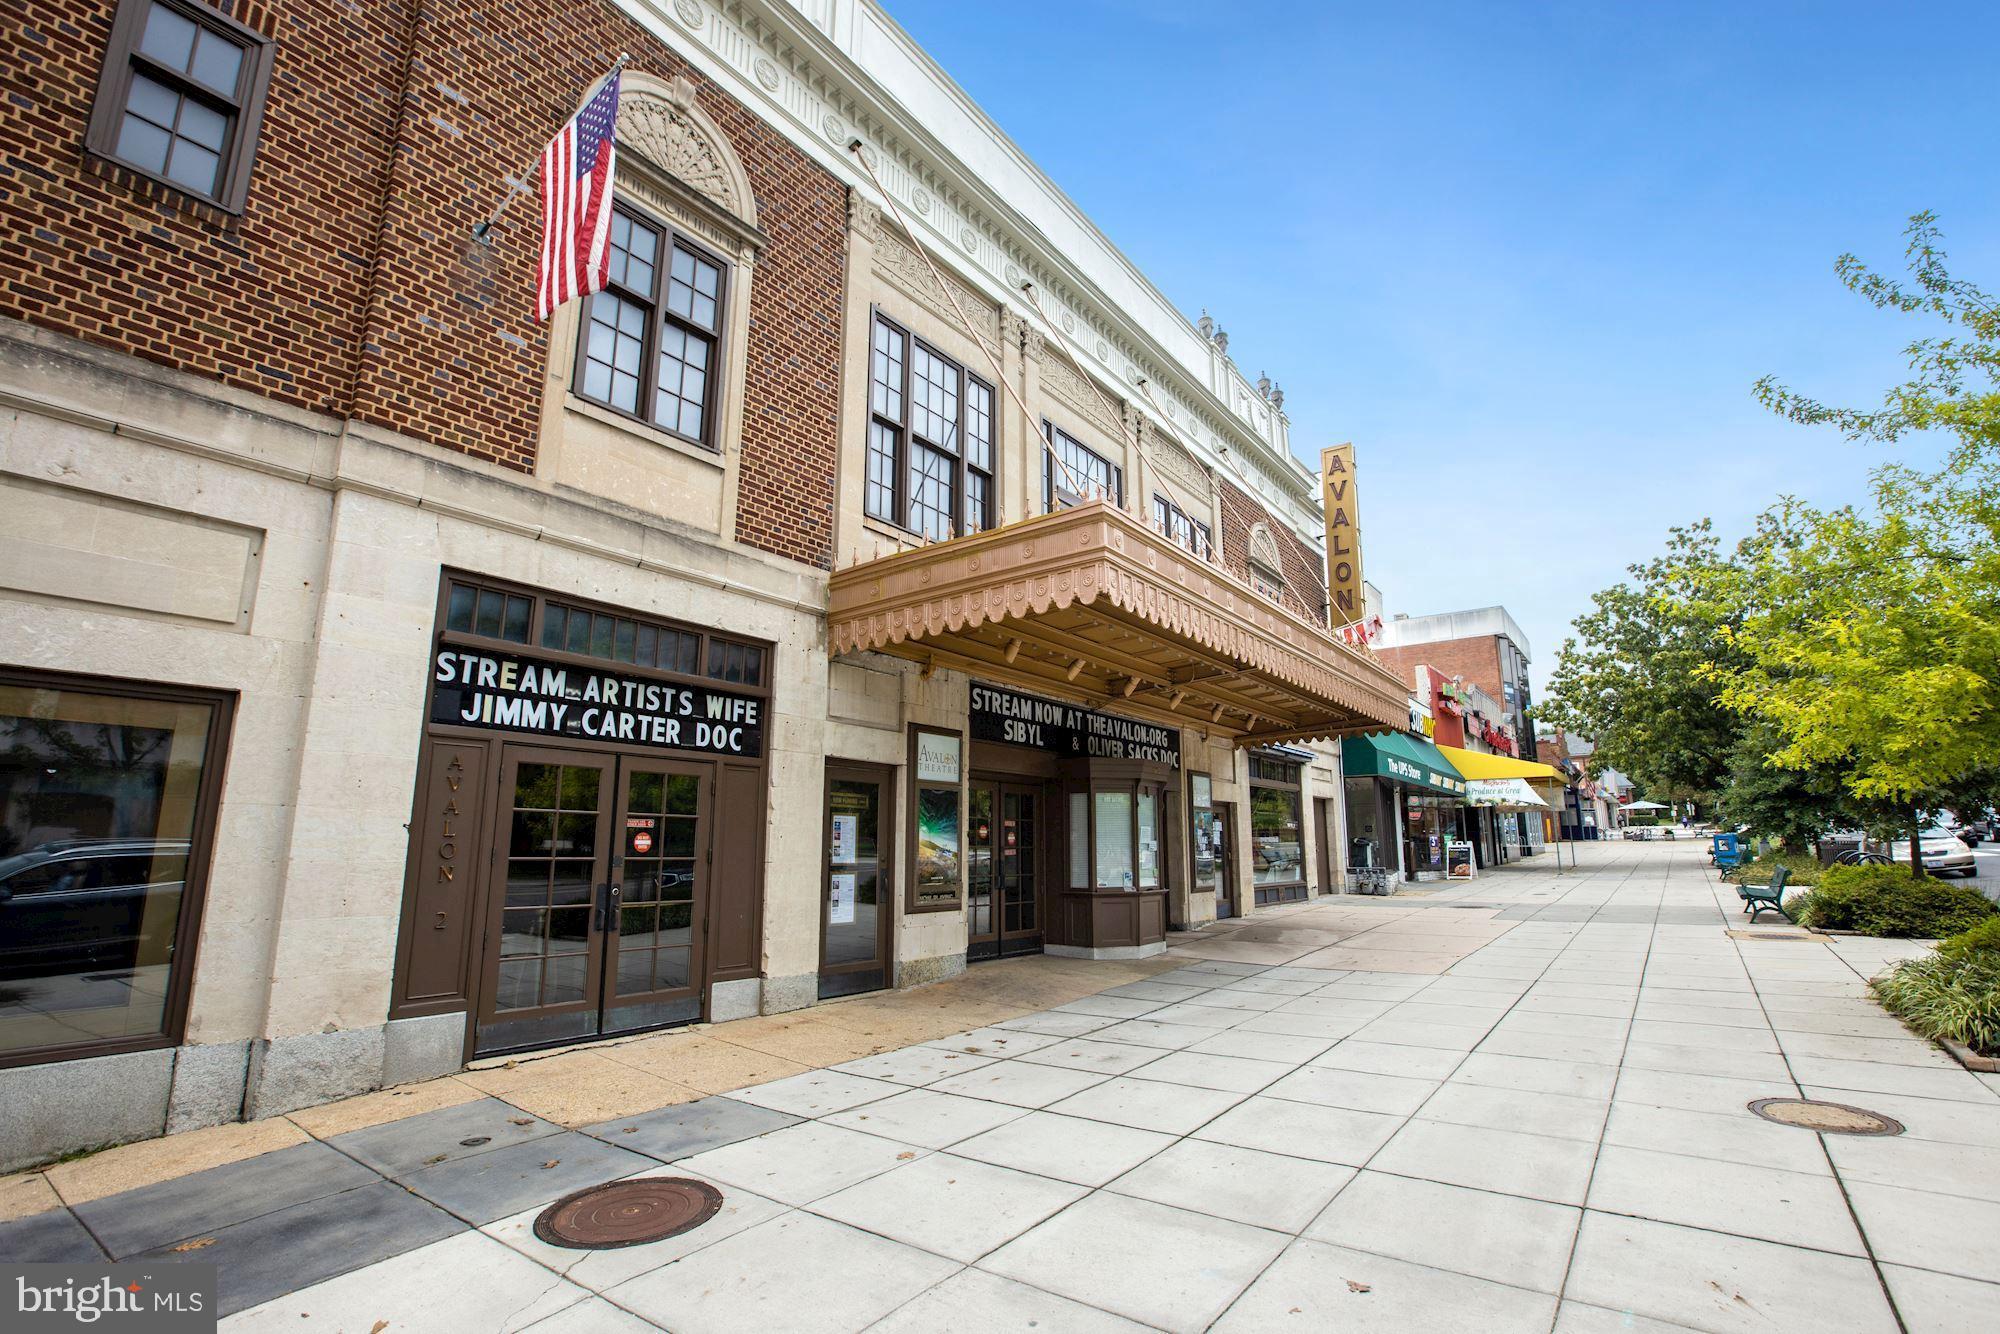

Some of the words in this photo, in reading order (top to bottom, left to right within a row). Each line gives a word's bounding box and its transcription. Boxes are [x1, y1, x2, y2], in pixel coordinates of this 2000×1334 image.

[1328, 454, 1354, 611] AVALON
[435, 651, 567, 698] STREAM
[705, 693, 758, 725] WIFE
[971, 687, 1032, 721] STREAM
[1034, 701, 1062, 727] NOW
[1066, 711, 1083, 730] AT
[1086, 713, 1168, 748] THEAVALON.ORG
[460, 692, 569, 731] JIMMY
[581, 707, 681, 746] CARTER
[695, 722, 743, 752] DOC
[1003, 719, 1044, 746] SIBYL
[1072, 736, 1080, 751] &
[1087, 735, 1124, 759] OLIVER
[1127, 742, 1159, 763] SACKS
[1160, 748, 1179, 769] DOC
[918, 762, 959, 775] THEATRE
[1387, 757, 1398, 773] The
[1397, 760, 1408, 776] UPS
[1407, 764, 1421, 780] Store
[438, 754, 463, 883] AVALON
[434, 911, 448, 929] 2
